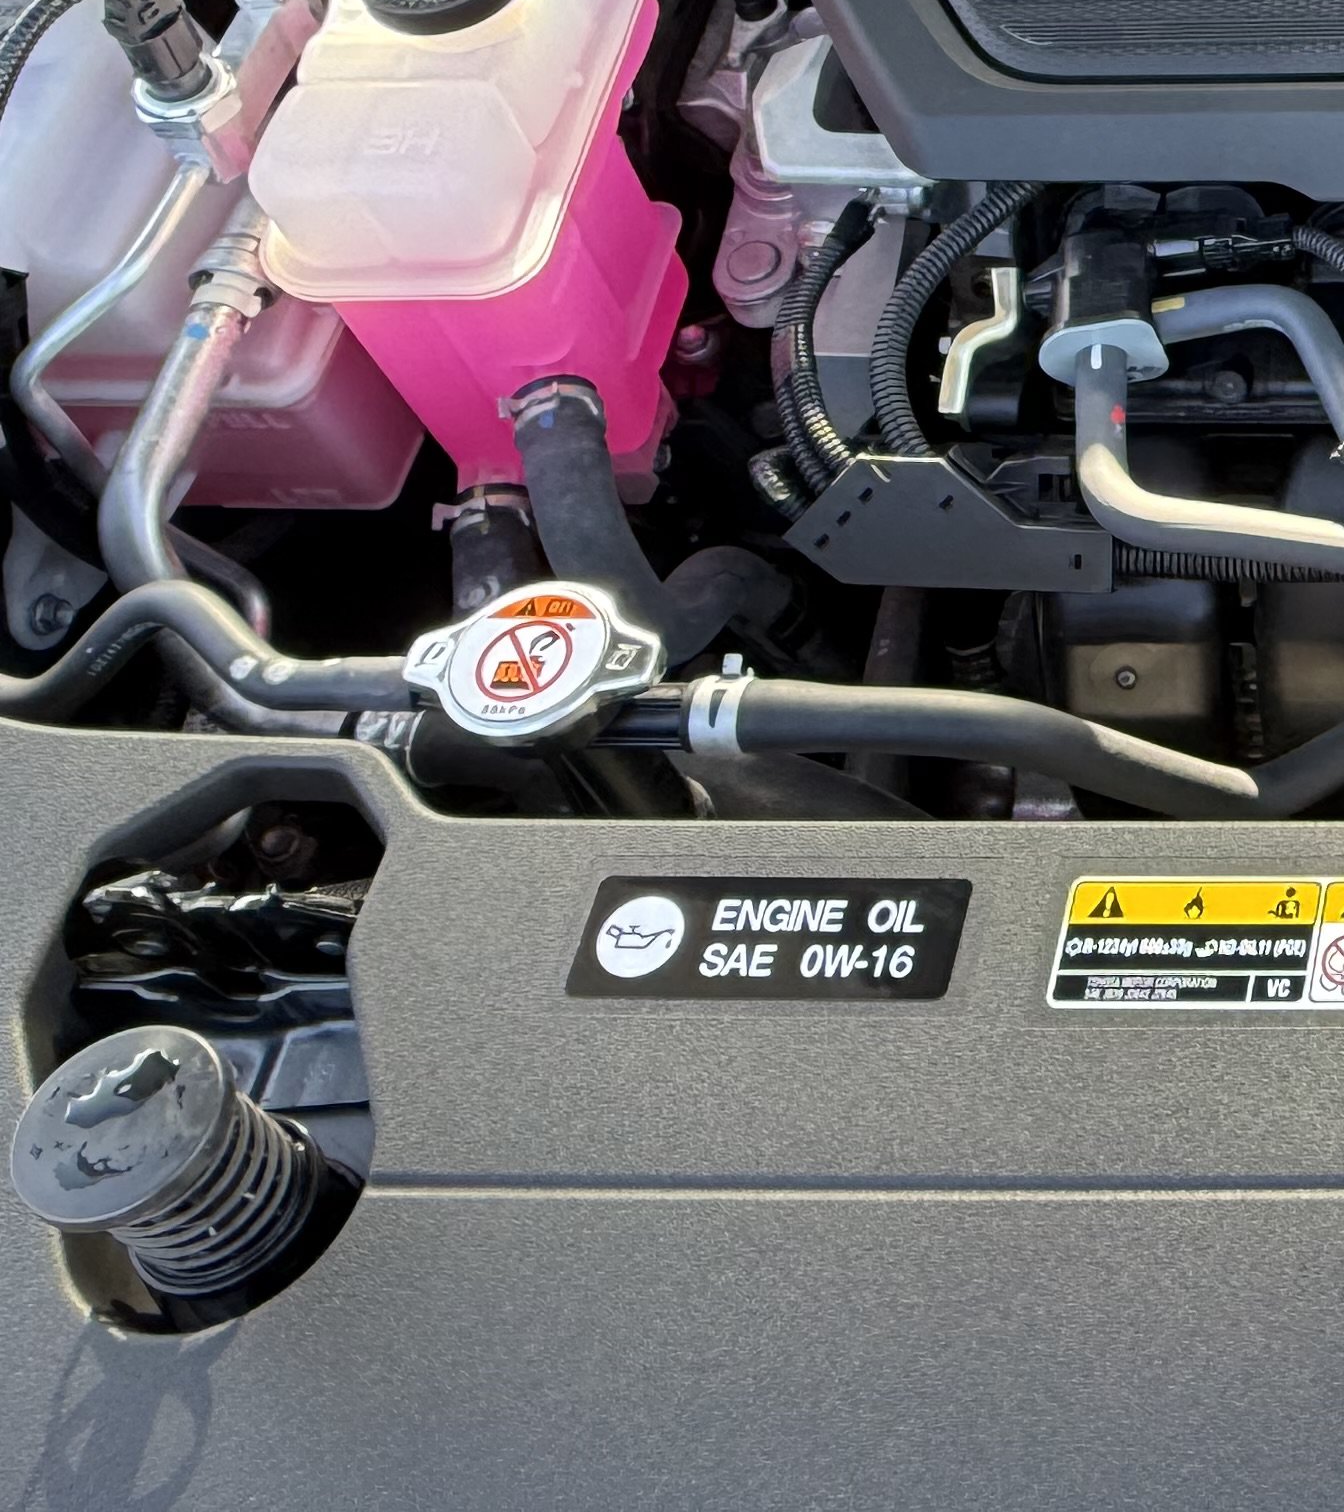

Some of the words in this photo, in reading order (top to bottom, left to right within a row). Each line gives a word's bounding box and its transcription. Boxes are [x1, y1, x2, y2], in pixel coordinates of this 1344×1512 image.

[711, 898, 848, 933] ENGINE
[867, 898, 924, 934] OIL
[699, 943, 778, 977] SAE
[800, 944, 915, 979] 0W-16
[1267, 978, 1291, 998] VC
